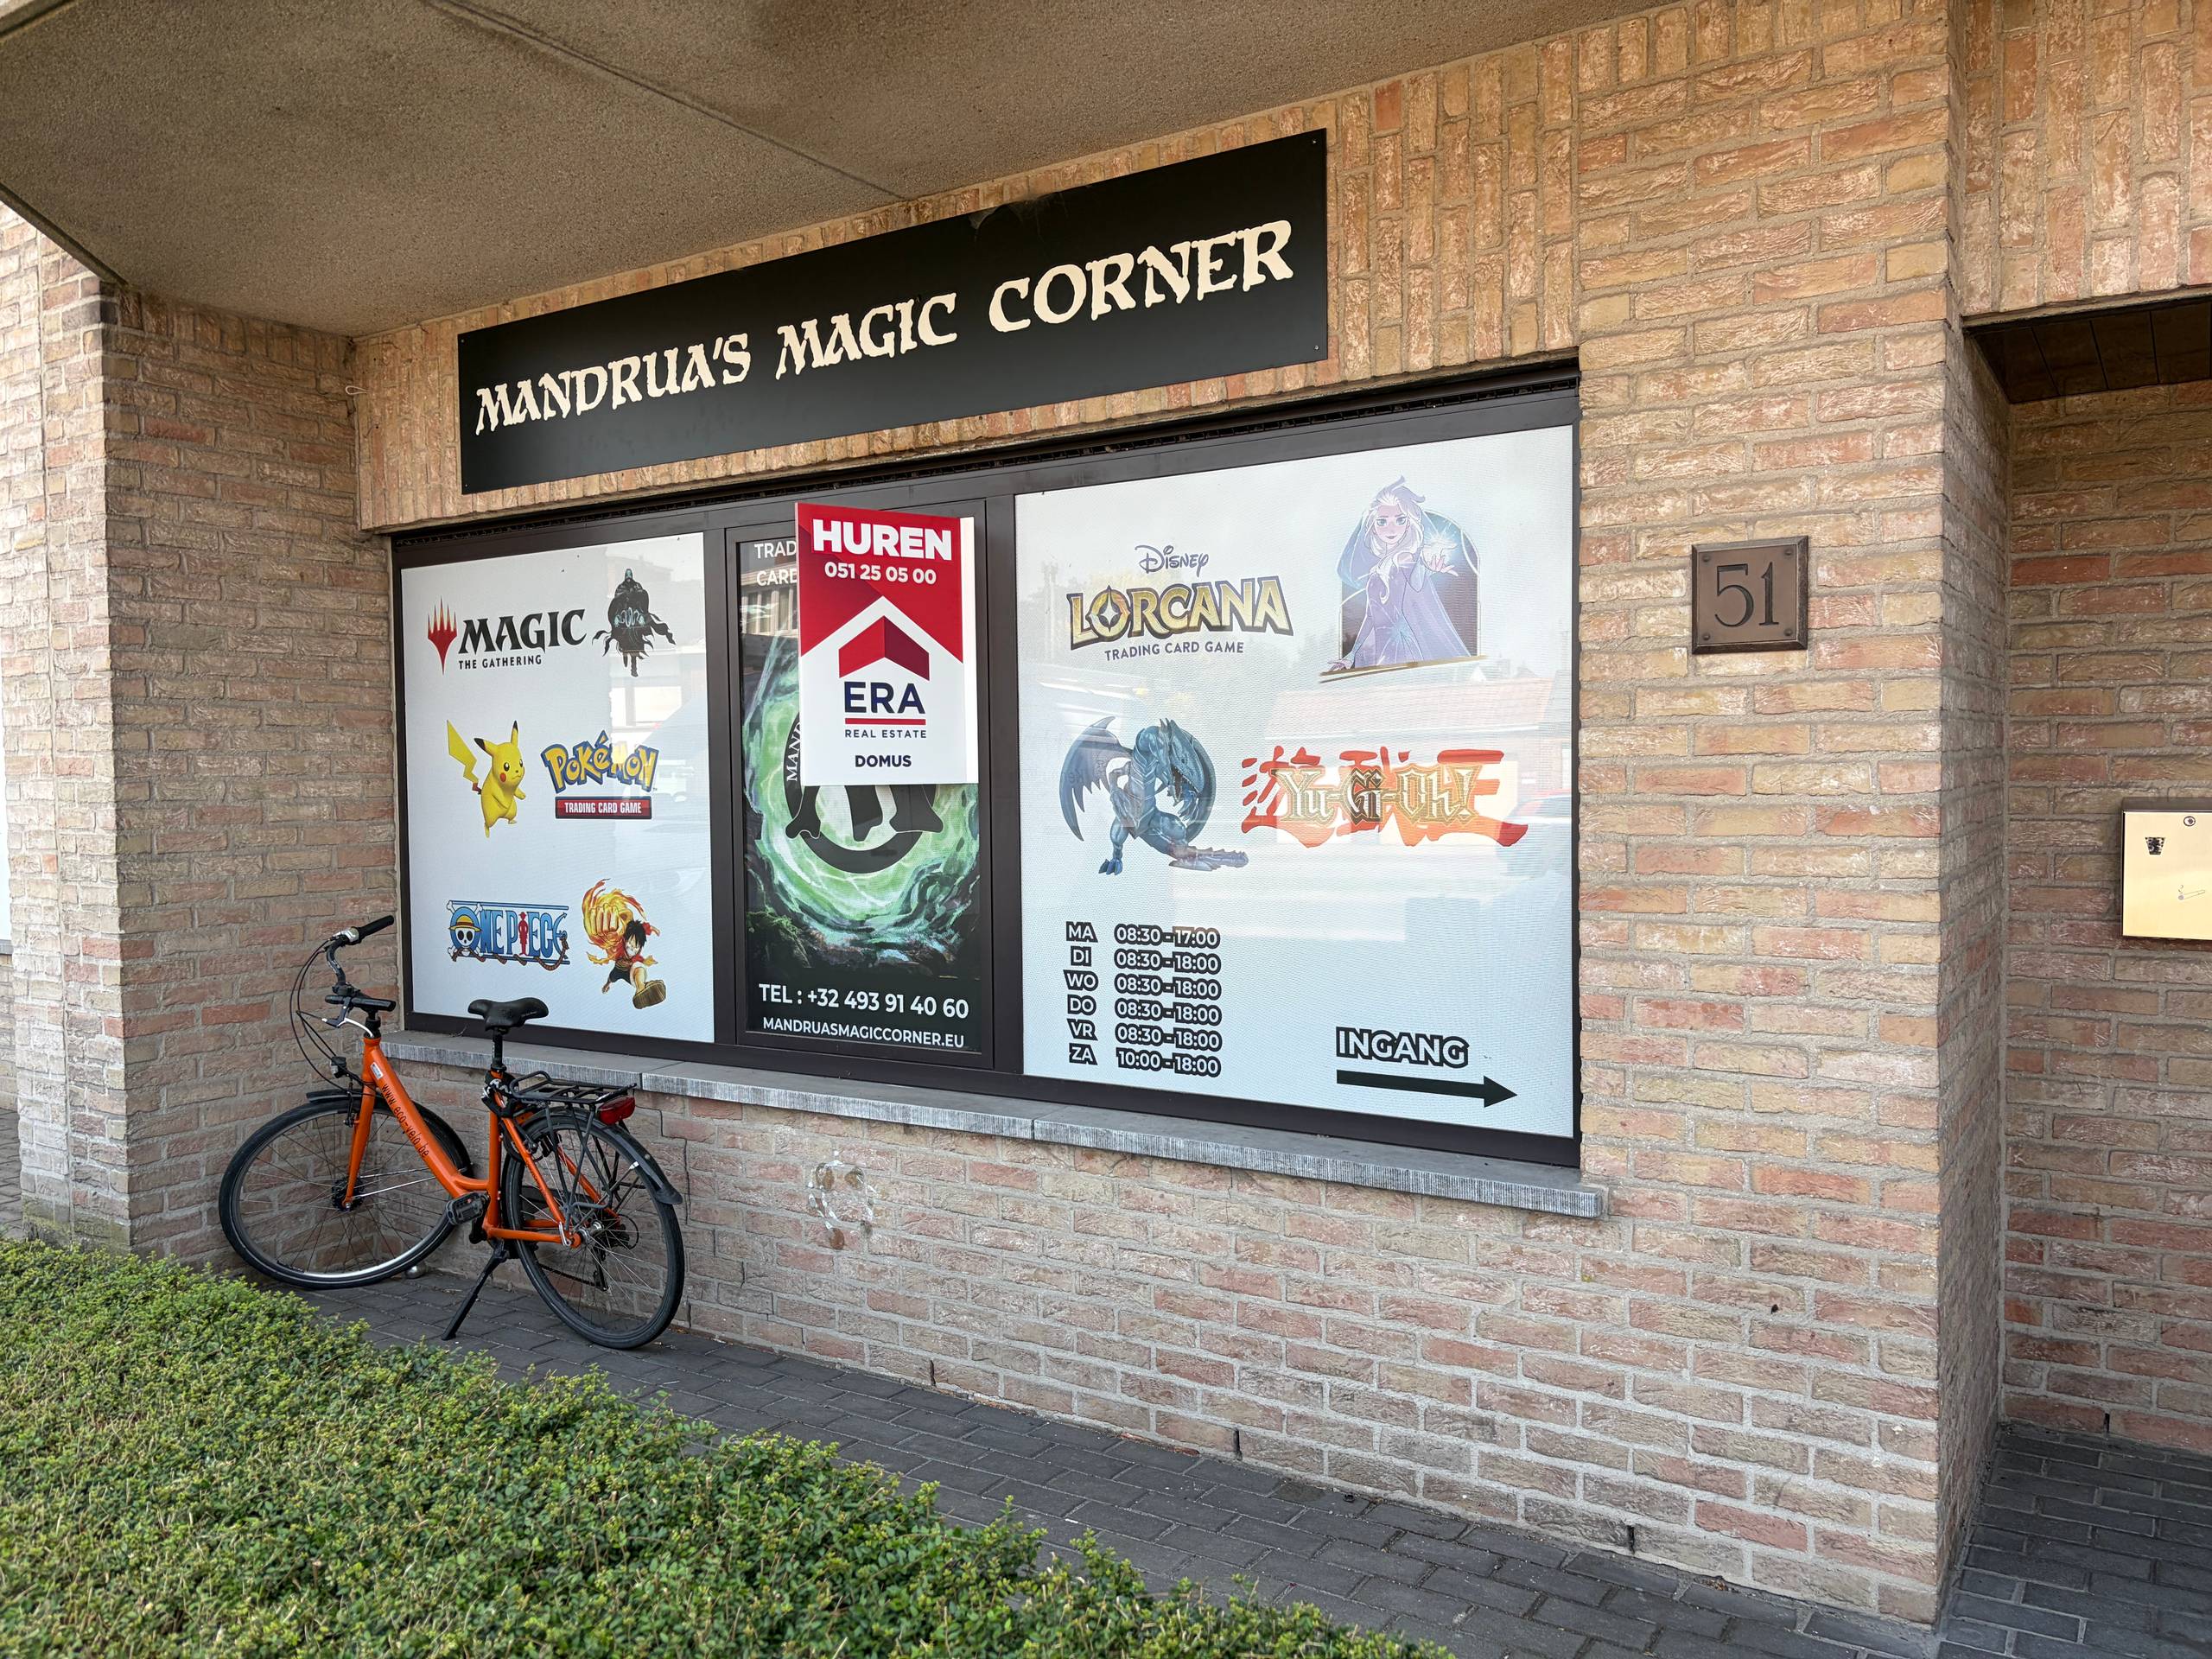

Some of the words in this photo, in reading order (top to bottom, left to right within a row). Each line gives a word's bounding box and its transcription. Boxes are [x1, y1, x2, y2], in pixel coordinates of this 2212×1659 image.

[476, 333, 751, 435] MANDRUA'S
[775, 292, 957, 380] MAGIC
[988, 219, 1294, 333] CORNER
[812, 518, 952, 561] HUREN
[824, 562, 855, 579] 051
[860, 564, 881, 581] 25
[886, 567, 908, 582] 05
[912, 569, 937, 584] 00
[1714, 562, 1779, 627] 51
[1066, 575, 1294, 650] LORCANA
[458, 609, 587, 654] MAGIC
[459, 660, 477, 670] THE
[482, 654, 542, 669] GATHERING
[1104, 644, 1160, 661] TRADING
[1165, 642, 1199, 654] CARD
[1205, 642, 1244, 654] GAME
[844, 681, 925, 714] ERA
[845, 729, 876, 738] REAL
[881, 729, 926, 738] ESTATE
[855, 754, 912, 767] DOMUS
[564, 802, 596, 814] TRADING
[598, 802, 618, 814] CARD
[620, 802, 642, 814] GAME
[450, 906, 505, 956] ONE
[1067, 923, 1096, 942] MA
[1115, 925, 1162, 944] 08:30
[1173, 928, 1219, 948] 17:00
[1071, 947, 1090, 965] DI
[1115, 950, 1162, 969] 08:30
[1173, 953, 1220, 974] 18:00
[1065, 970, 1097, 990] WO
[1116, 974, 1162, 994] 08:30
[1173, 978, 1221, 999] 18:00
[758, 983, 792, 1004] TEL
[808, 988, 839, 1007] +32
[844, 990, 880, 1011] 493
[885, 994, 904, 1013] 91
[910, 995, 937, 1016] 40
[943, 998, 969, 1019] 60
[1069, 995, 1096, 1014] DO
[1116, 1000, 1163, 1020] 08:30
[1174, 1003, 1221, 1025] 18:00
[763, 1017, 965, 1048] MANDRUASMAGICCORNER.EU
[1068, 1020, 1096, 1039] VR
[1116, 1025, 1163, 1045] 08:30
[1174, 1028, 1222, 1050] 18:00
[1337, 1027, 1469, 1067] INGANG
[1071, 1044, 1096, 1064] ZA
[1116, 1048, 1163, 1071] 10:00
[1173, 1054, 1220, 1076] 18:00
